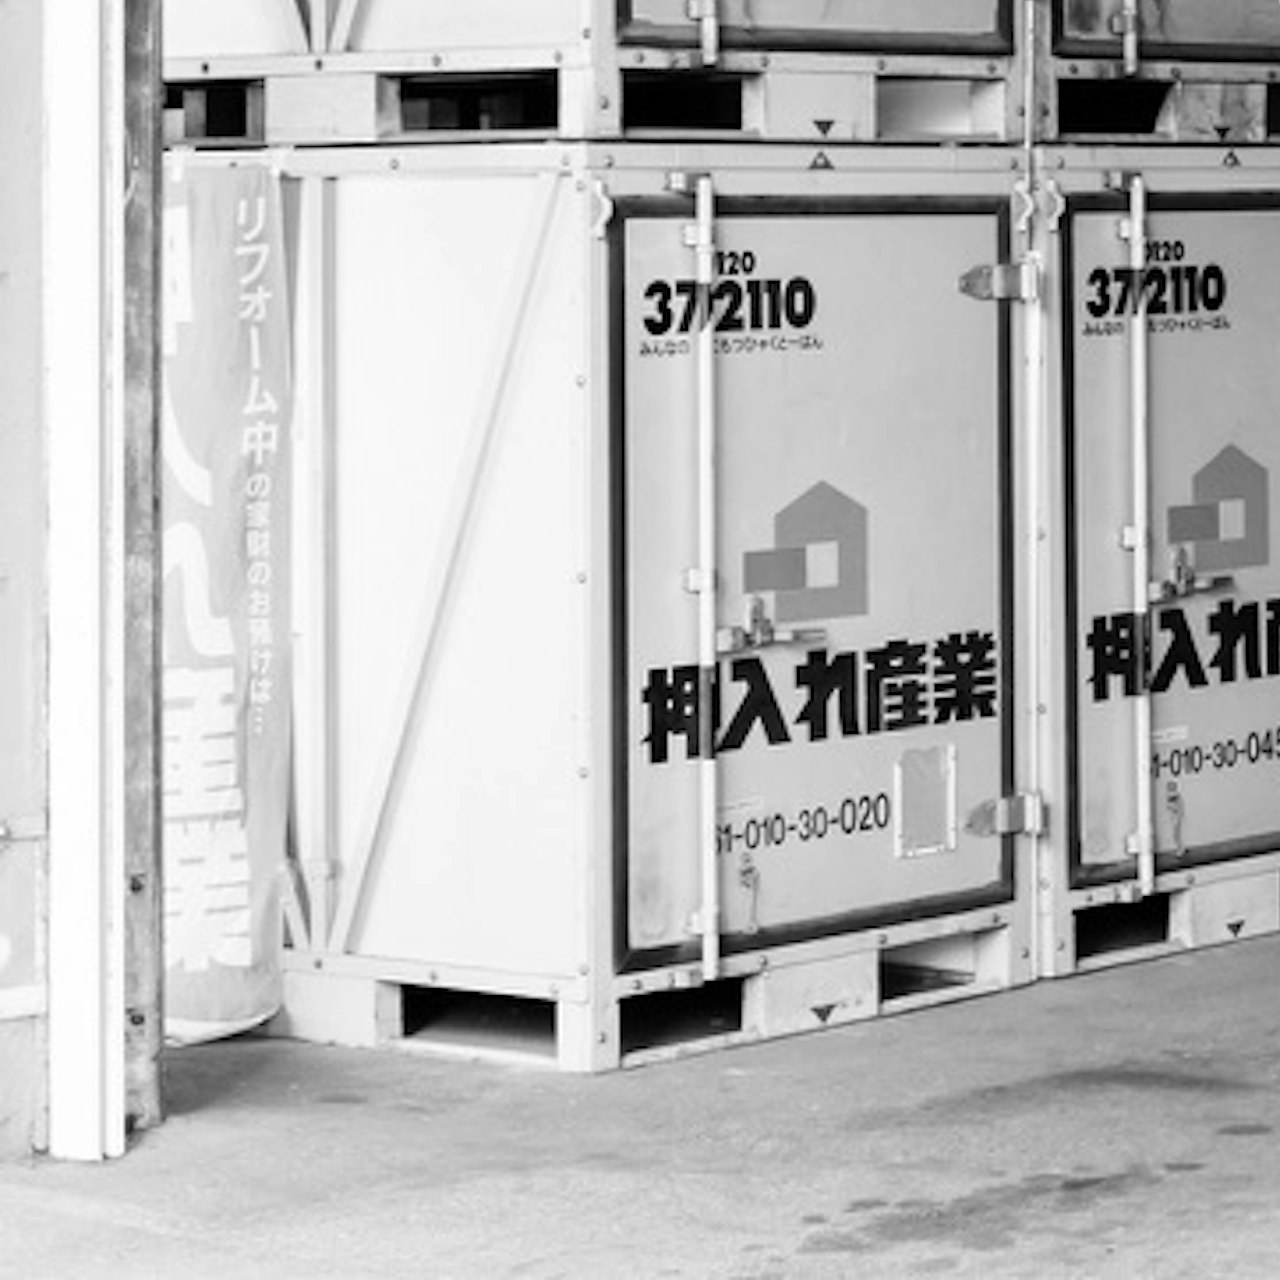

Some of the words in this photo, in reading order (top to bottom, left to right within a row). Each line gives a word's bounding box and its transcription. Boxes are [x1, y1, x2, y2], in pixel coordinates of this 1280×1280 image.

[714, 251, 756, 275] 120
[641, 631, 997, 763] 押入れ産業
